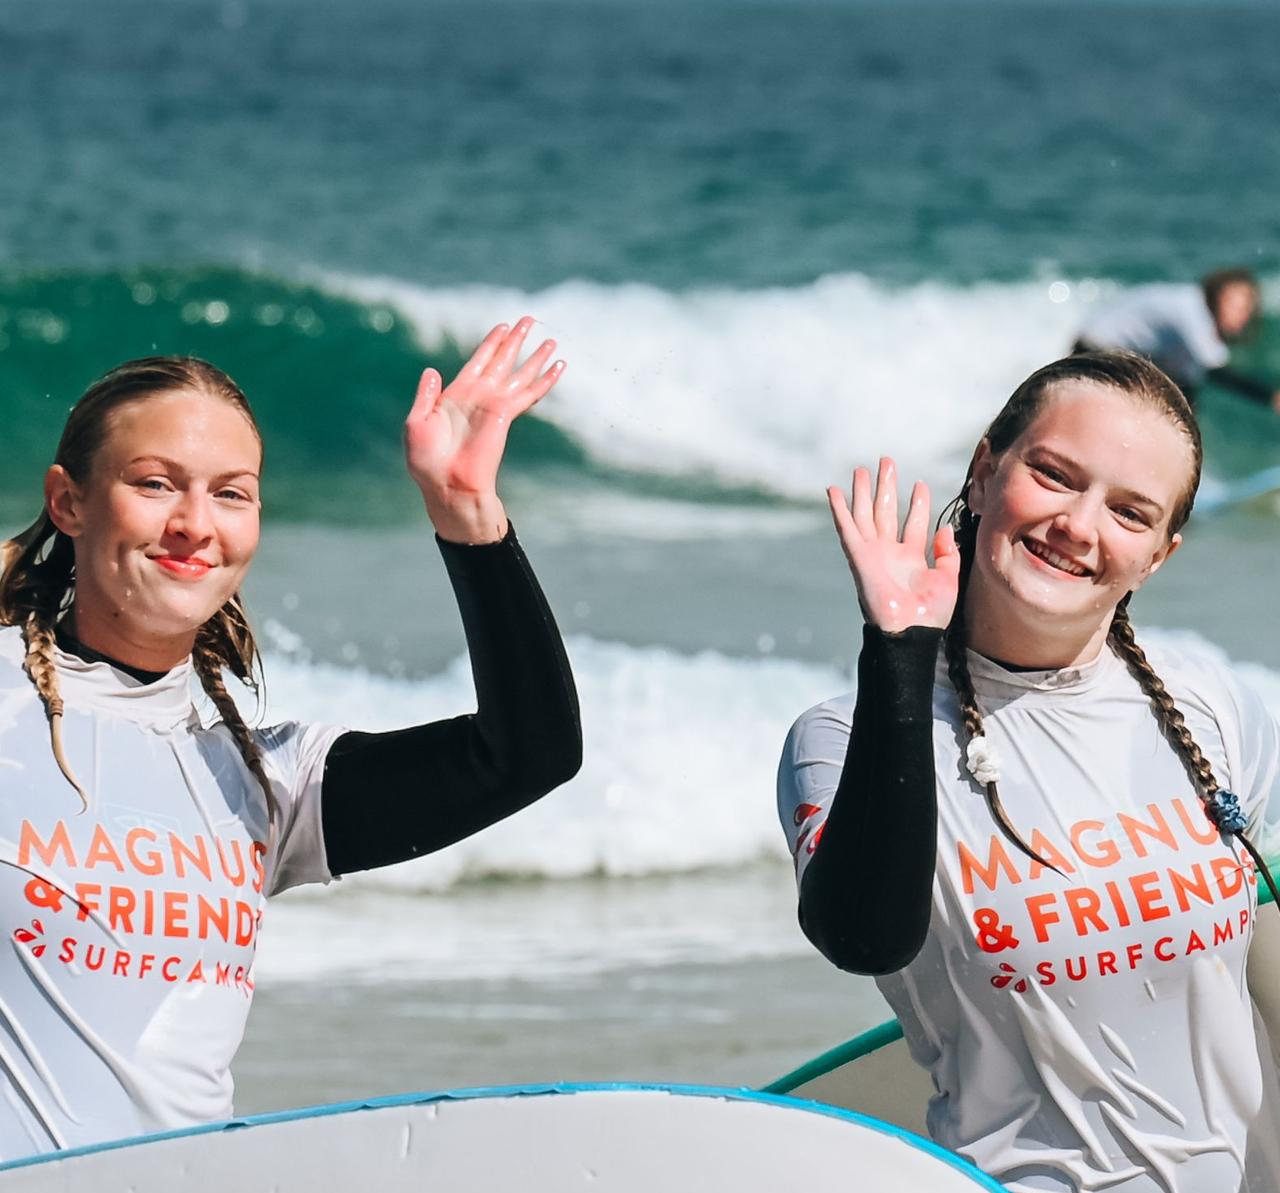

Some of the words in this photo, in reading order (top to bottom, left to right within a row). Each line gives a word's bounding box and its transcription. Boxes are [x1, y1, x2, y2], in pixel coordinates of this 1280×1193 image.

[17, 819, 267, 894] MAGNUS
[957, 797, 1219, 894] MAGNU
[23, 876, 64, 913] &
[74, 882, 262, 948] FRIEND
[973, 907, 1020, 953] &
[1036, 909, 1249, 987] SURFCAMP
